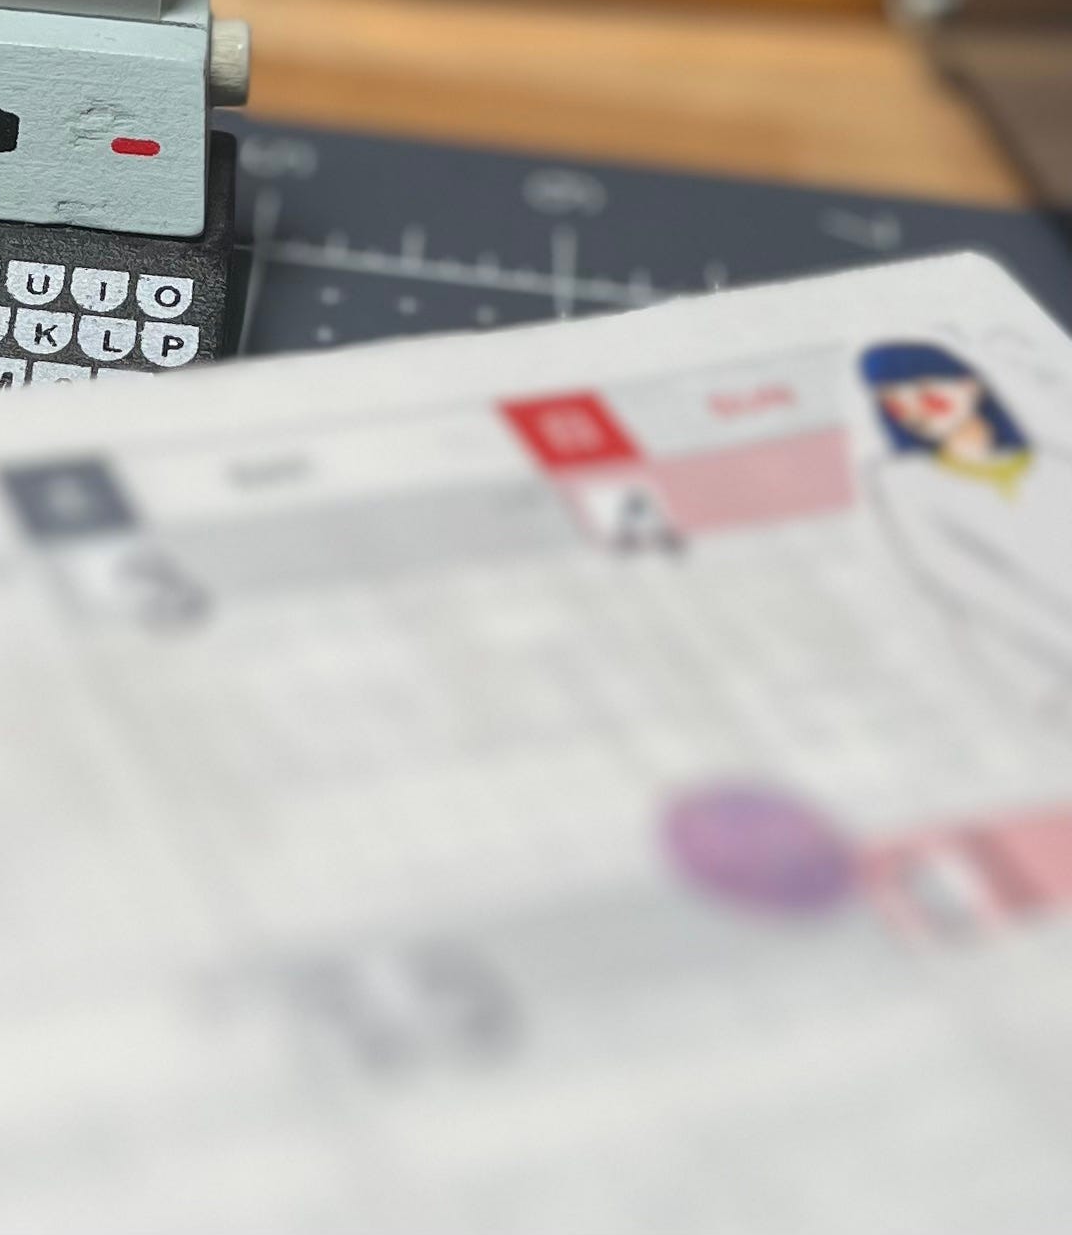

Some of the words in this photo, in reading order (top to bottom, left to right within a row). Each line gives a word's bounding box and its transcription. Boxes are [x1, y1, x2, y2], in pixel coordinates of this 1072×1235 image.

[27, 274, 50, 295] U
[99, 281, 108, 302] I
[154, 285, 181, 308] O
[34, 323, 59, 347] K
[102, 330, 123, 353] L
[161, 335, 185, 357] P
